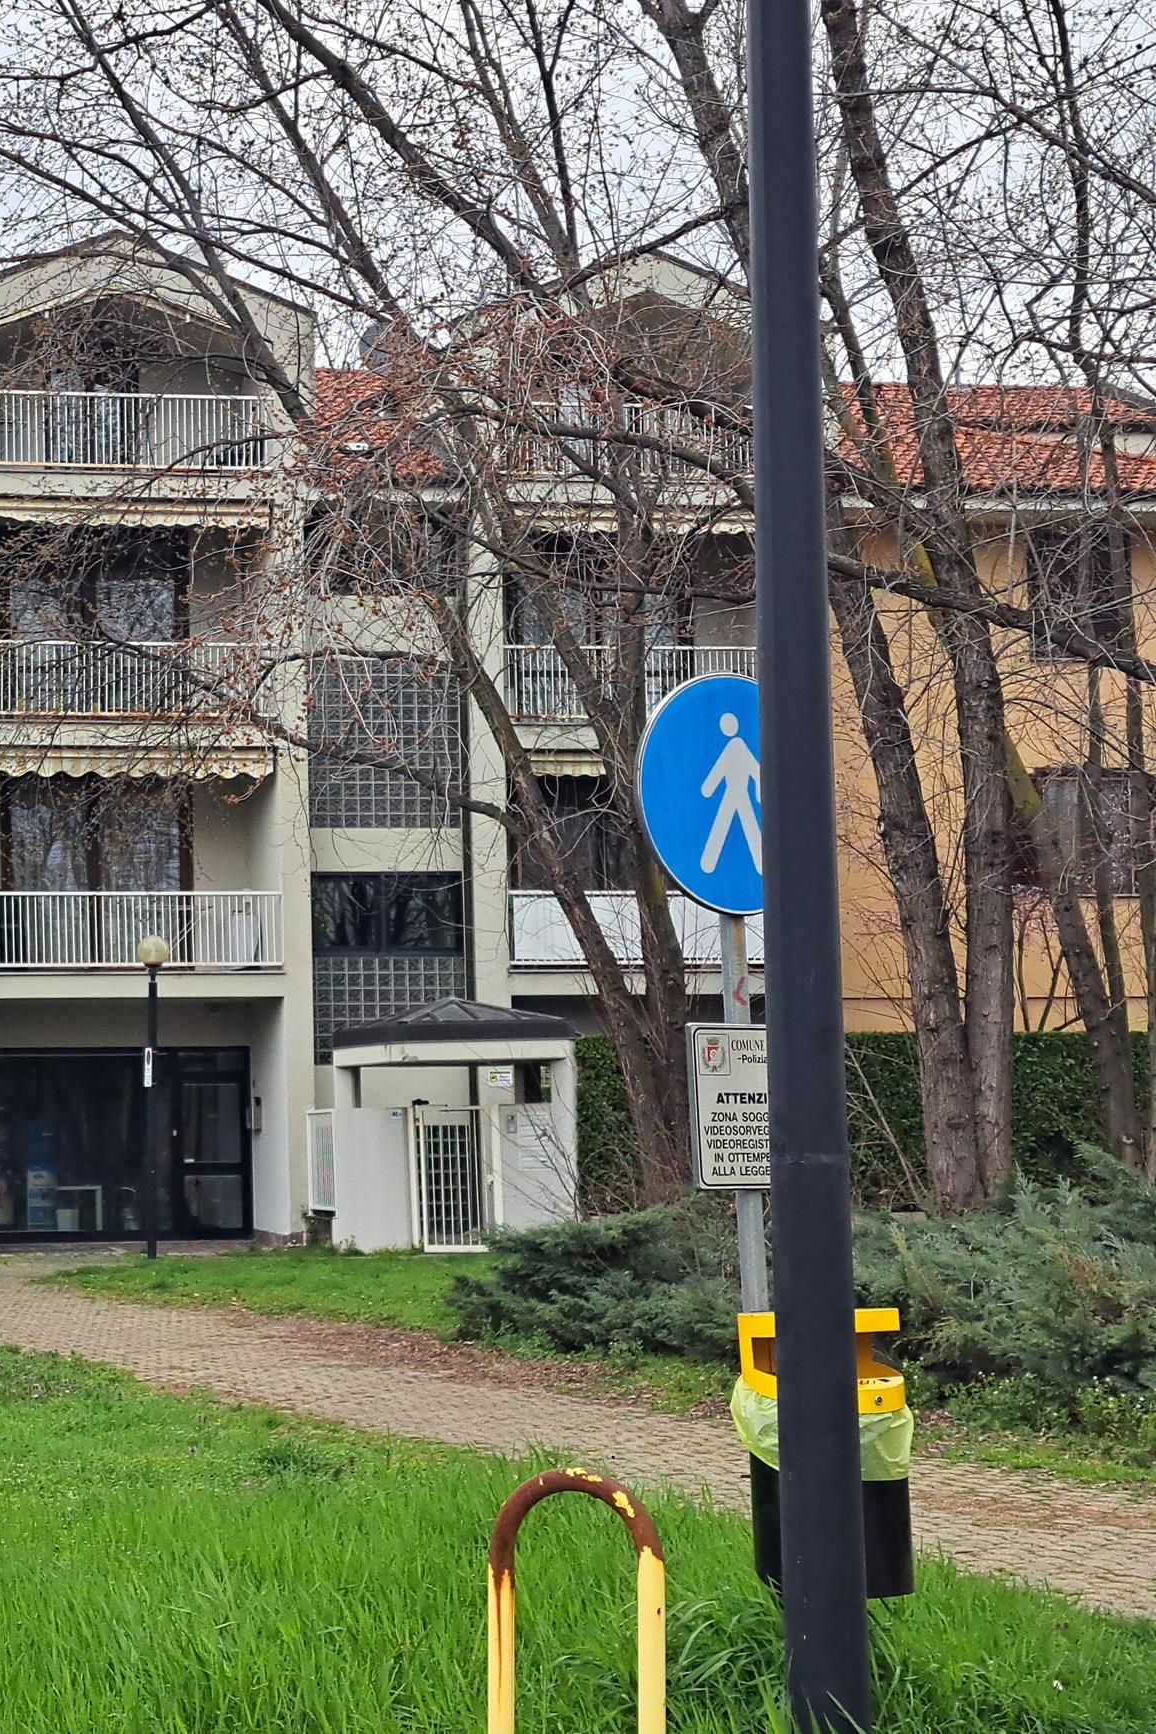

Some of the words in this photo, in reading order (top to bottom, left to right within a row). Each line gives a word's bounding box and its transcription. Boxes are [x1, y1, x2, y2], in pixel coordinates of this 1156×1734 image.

[731, 1039, 764, 1051] COMUNE
[711, 1112, 738, 1122] ZONA
[714, 1152, 724, 1163] IN
[712, 1165, 736, 1176] ALLA
[740, 1165, 771, 1176] LEGGE
